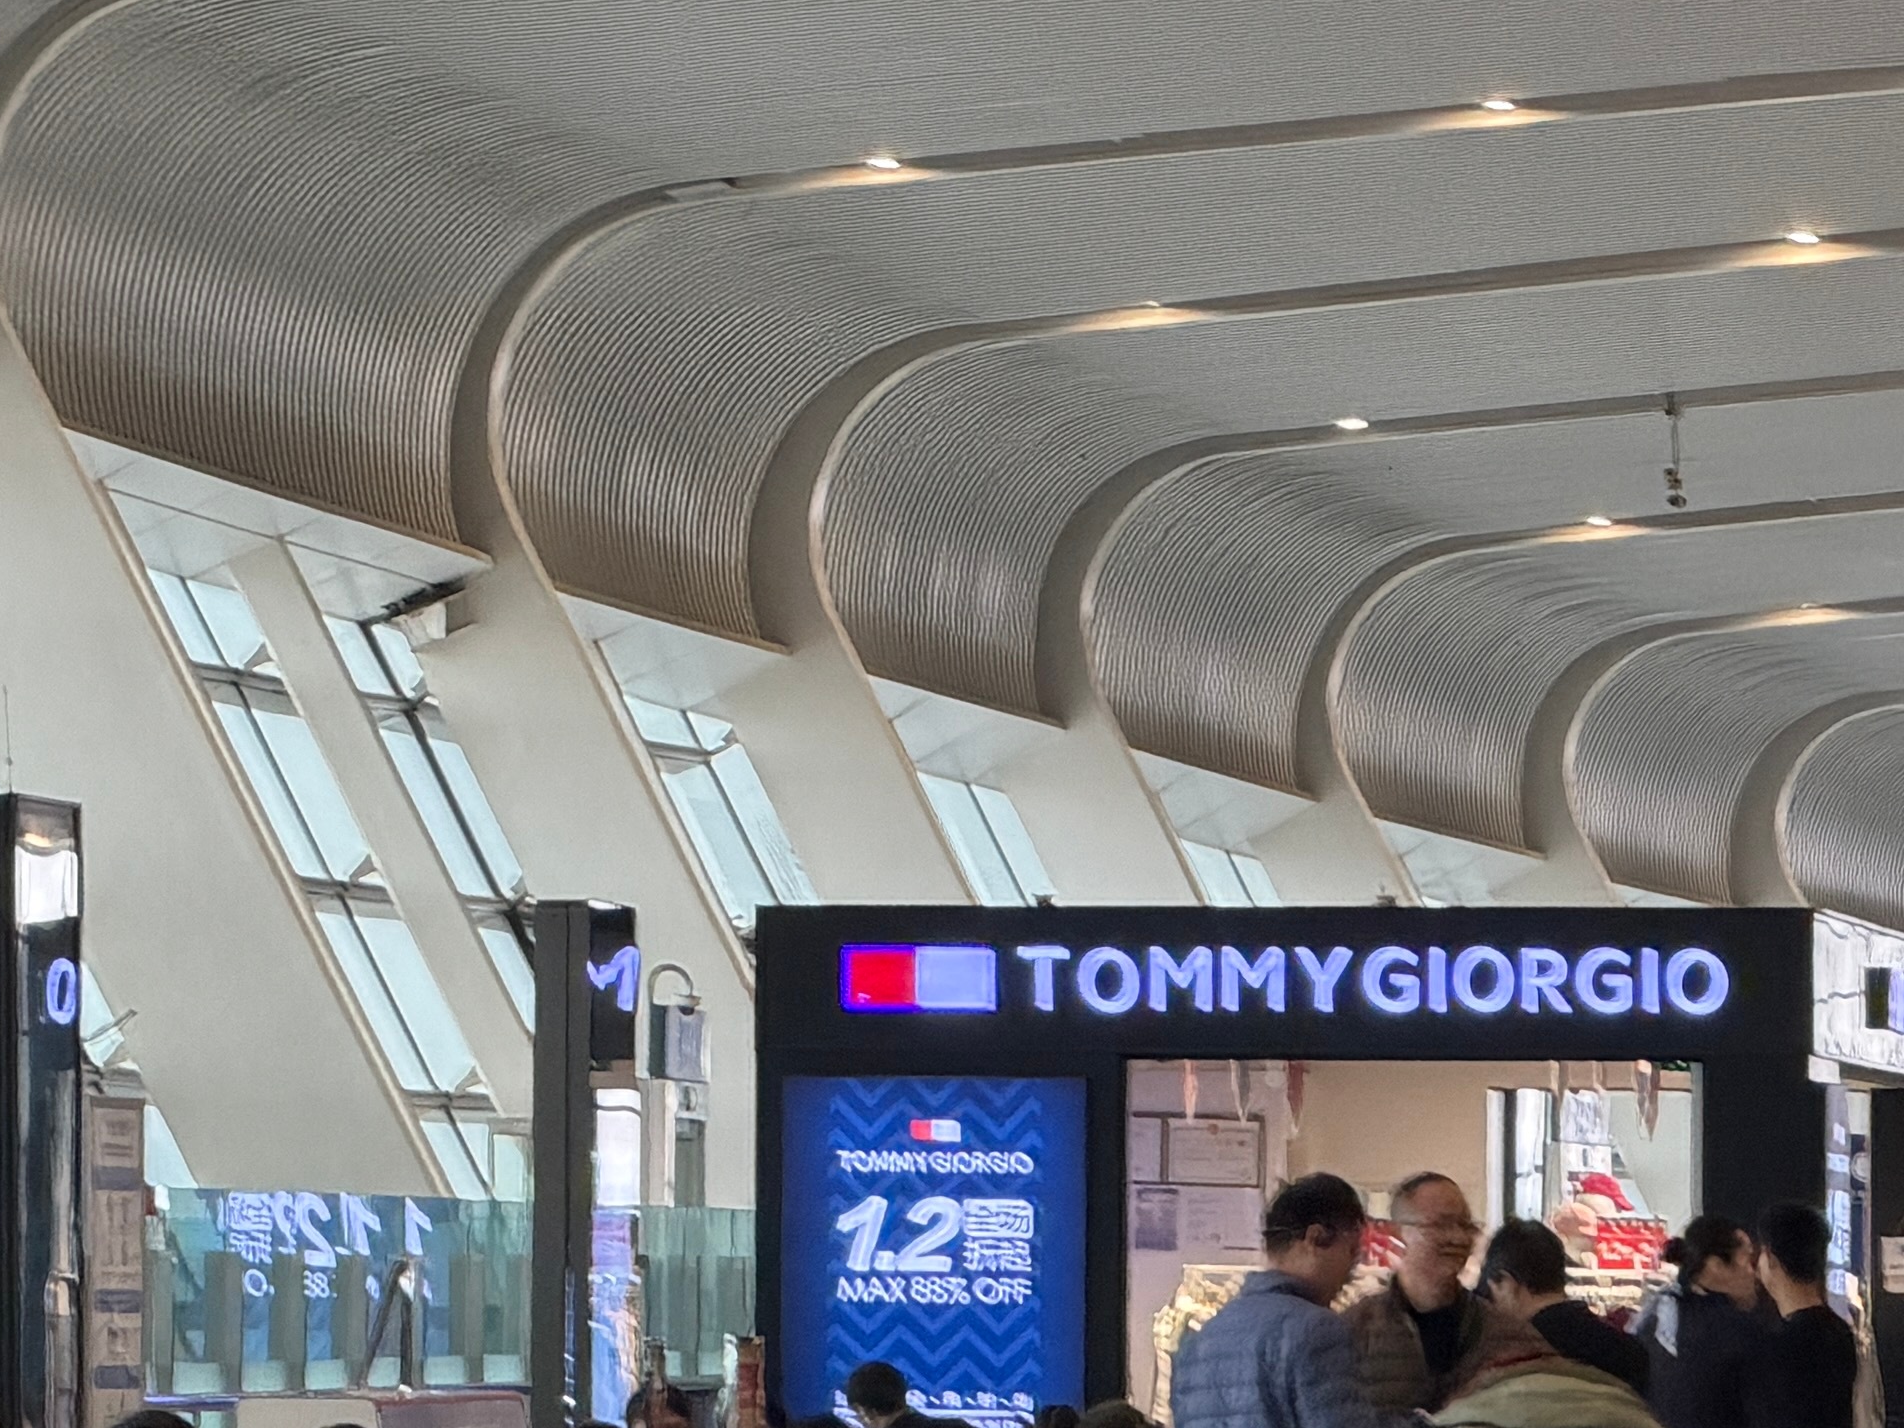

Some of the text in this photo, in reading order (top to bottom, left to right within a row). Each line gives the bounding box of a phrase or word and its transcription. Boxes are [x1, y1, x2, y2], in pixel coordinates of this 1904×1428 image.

[1016, 945, 1731, 1015] TOMMYGIORGIO
[836, 1195, 961, 1271] 1.2
[836, 1275, 907, 1304] MAX
[972, 1275, 1033, 1305] OFF
